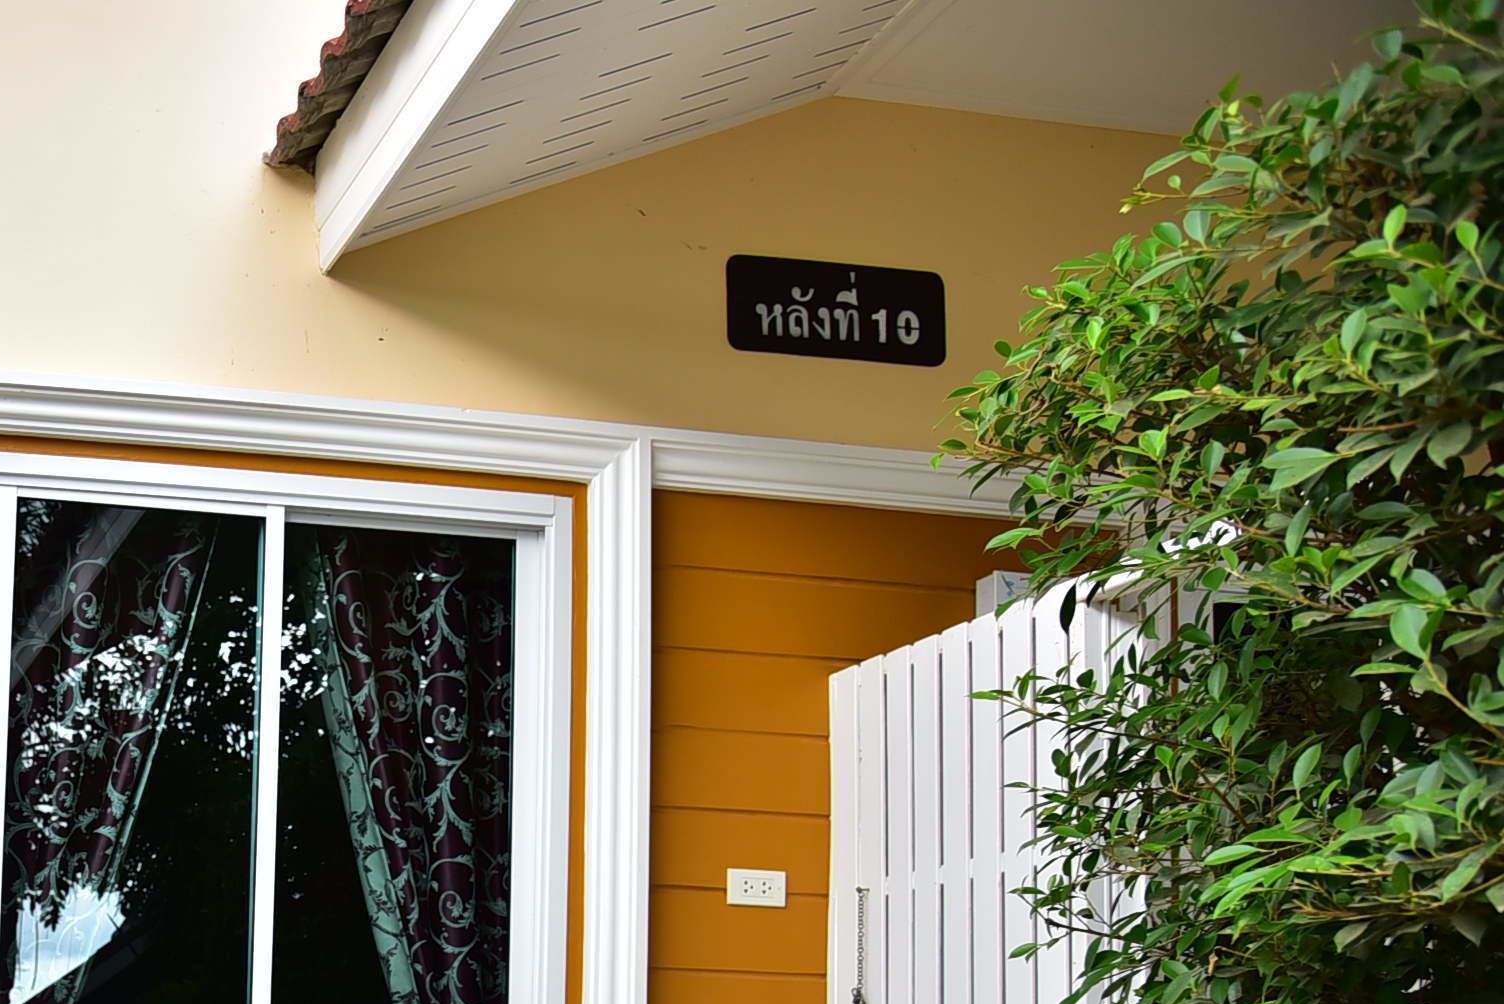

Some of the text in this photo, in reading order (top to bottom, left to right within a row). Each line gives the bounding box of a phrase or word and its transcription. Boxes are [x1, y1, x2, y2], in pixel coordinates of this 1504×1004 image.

[755, 271, 921, 345] หลังที่ 10
